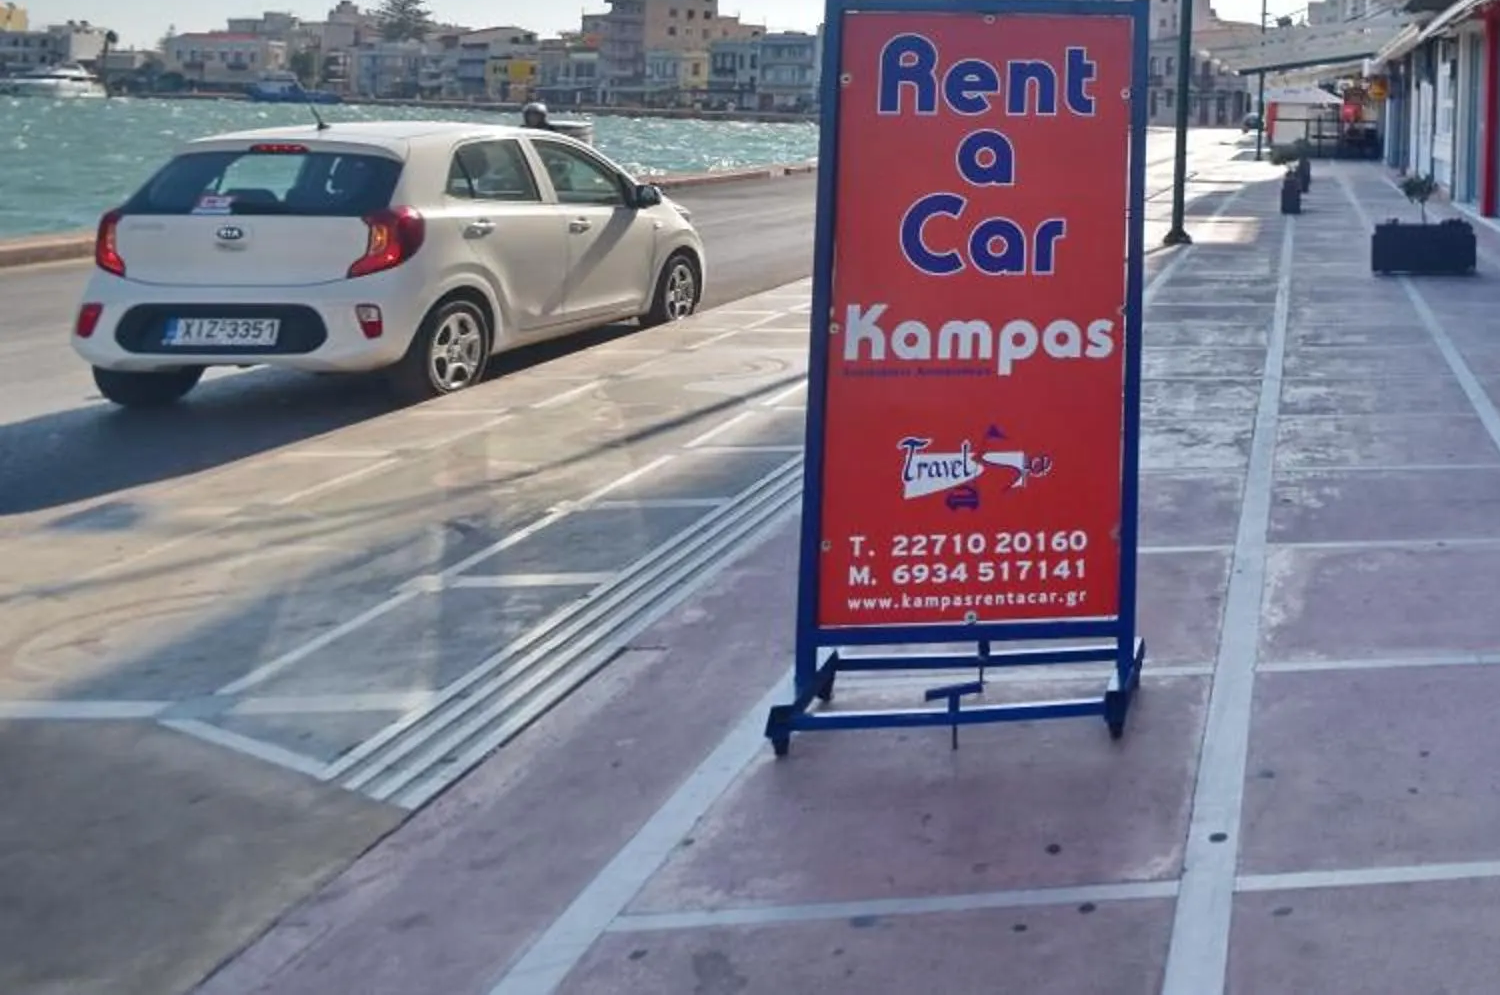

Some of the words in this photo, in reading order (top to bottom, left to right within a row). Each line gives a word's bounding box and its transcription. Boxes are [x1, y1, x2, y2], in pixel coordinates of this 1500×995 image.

[877, 32, 1097, 117] Rent
[955, 129, 1016, 187] a
[218, 228, 241, 239] KIA
[900, 192, 1067, 277] Car
[844, 303, 1115, 375] Kampas
[898, 438, 973, 482] Travel
[849, 536, 875, 557] T.
[892, 533, 986, 556] 22710
[995, 531, 1088, 553] 20160
[848, 566, 877, 586] M.
[892, 562, 968, 584] 6934
[978, 558, 1086, 582] 517141
[848, 589, 1087, 611] www.kampasrentacar.gr
